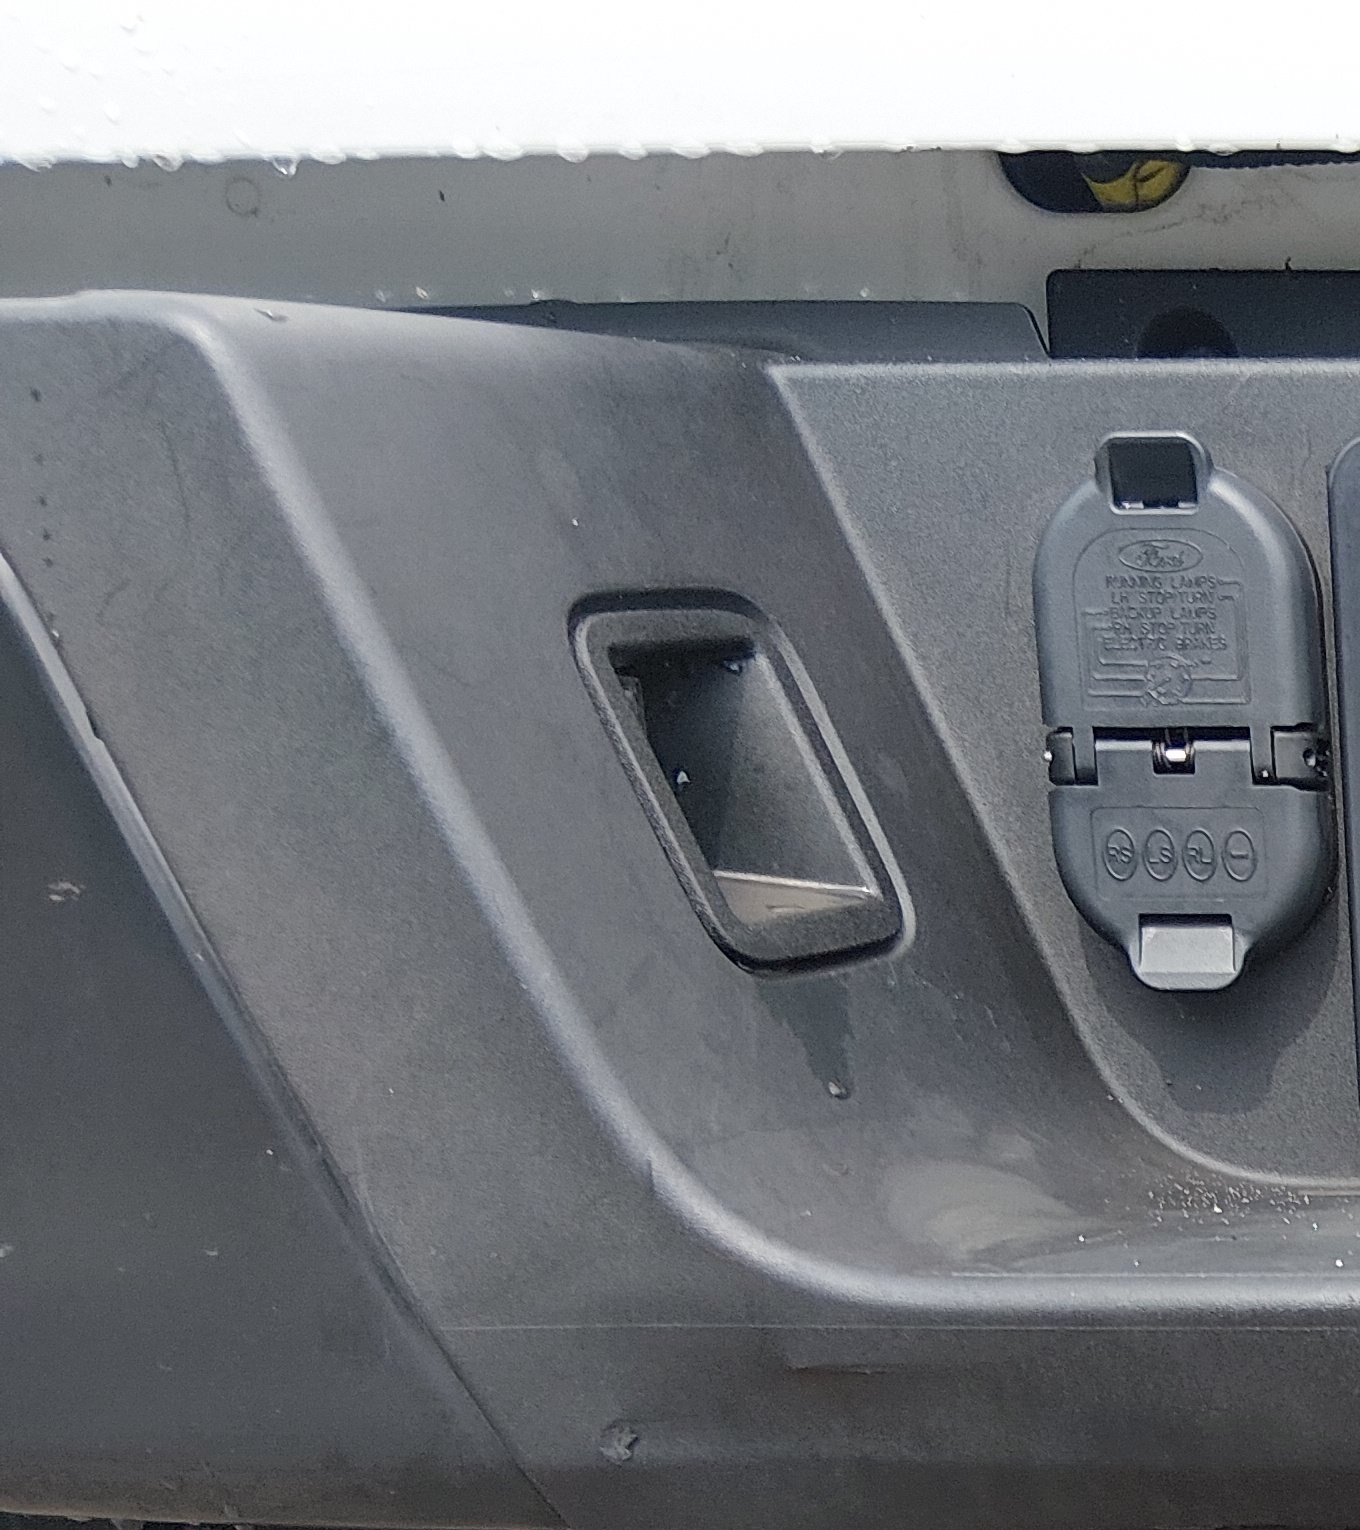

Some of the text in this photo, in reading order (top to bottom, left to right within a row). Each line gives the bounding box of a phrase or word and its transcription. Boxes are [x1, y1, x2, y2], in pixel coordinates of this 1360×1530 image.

[1106, 575, 1216, 590] RUNNING LAMPS
[1110, 607, 1216, 620] BACKUP LAMPS
[1176, 635, 1227, 650] BRAKES
[1108, 844, 1135, 865] RS
[1148, 844, 1174, 865] LS
[1187, 844, 1213, 865] RL
